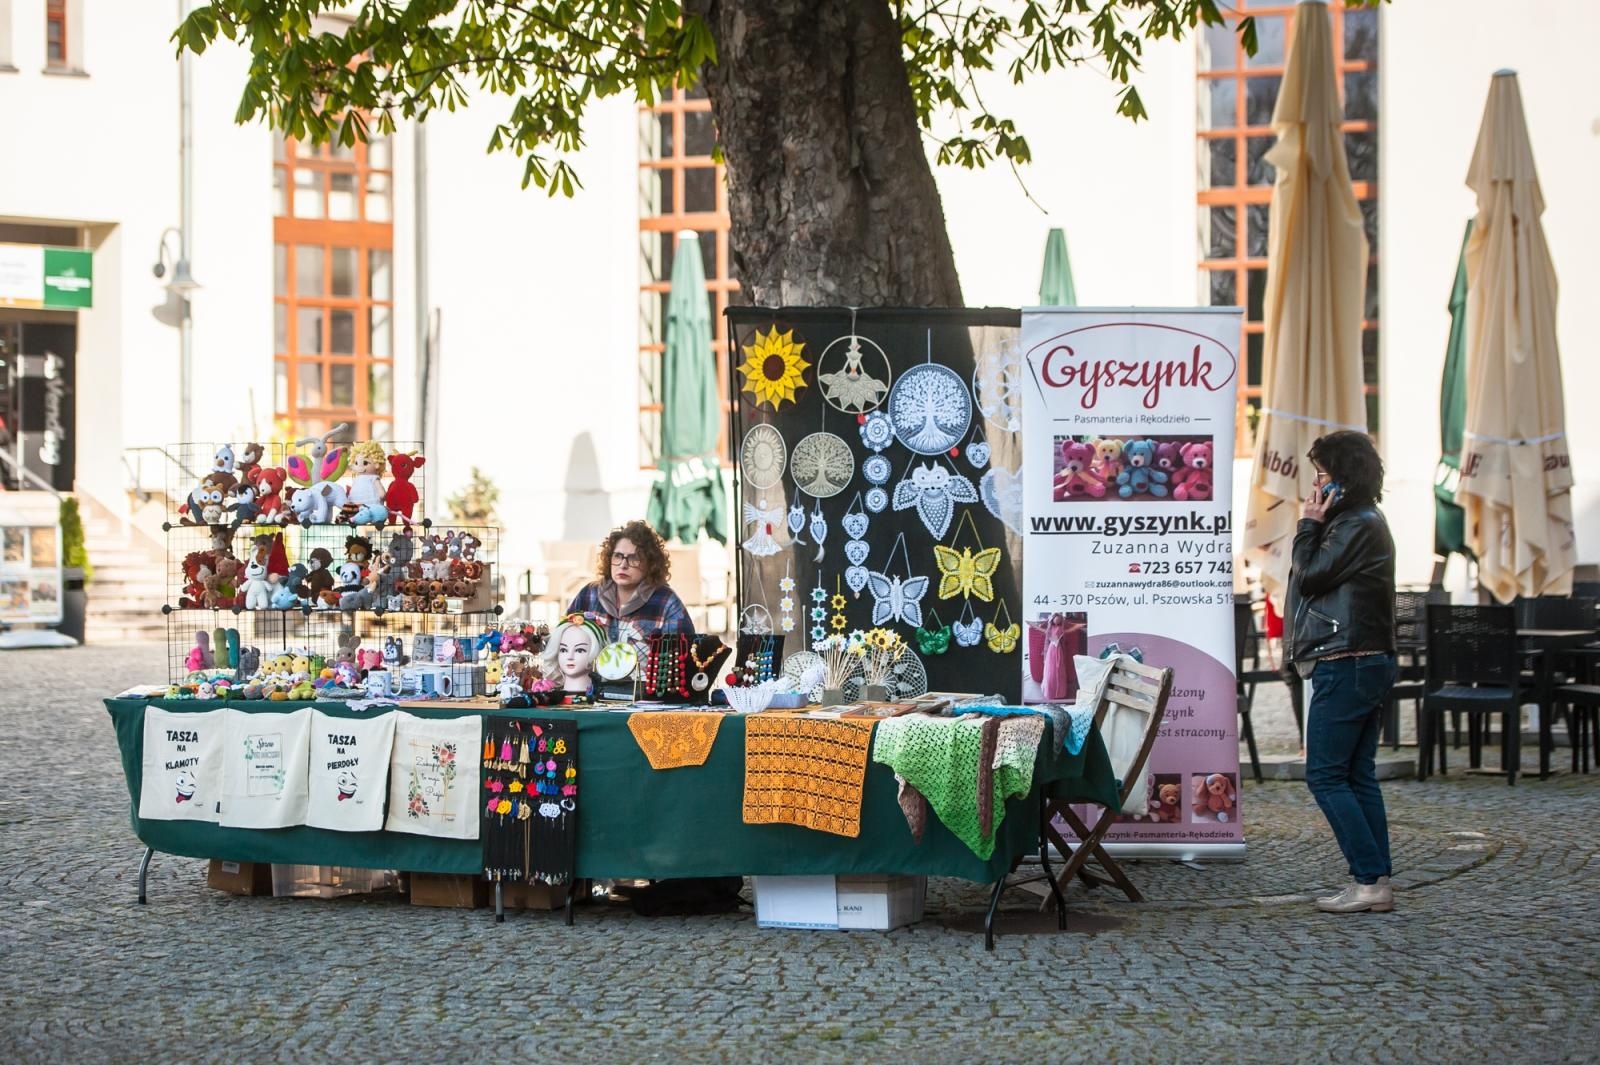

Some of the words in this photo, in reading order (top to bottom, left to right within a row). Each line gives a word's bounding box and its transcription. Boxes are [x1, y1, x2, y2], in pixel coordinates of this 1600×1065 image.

[1042, 344, 1213, 409] Gyszynk
[1074, 414, 1133, 424] Pasmanteria
[1135, 414, 1139, 424] i
[1140, 414, 1191, 425] Rękodzieło
[1030, 511, 1232, 536] www.gyszynk.pl
[1091, 540, 1169, 555] Zuzanna
[1177, 540, 1232, 557] Wydra
[1143, 561, 1170, 574] 723
[1174, 561, 1204, 574] 657
[1207, 561, 1232, 574] 742
[1033, 594, 1050, 606] 44
[1060, 594, 1083, 606] 370
[1087, 592, 1130, 607] Pszów,
[1133, 593, 1149, 605] ul.
[1152, 593, 1213, 606] Pszowska
[1169, 686, 1205, 701] dzony
[166, 730, 199, 743] TASZA
[327, 733, 357, 746] TASZA
[176, 744, 187, 752] NA
[336, 747, 346, 755] NA
[165, 757, 199, 770] KLAMOTY
